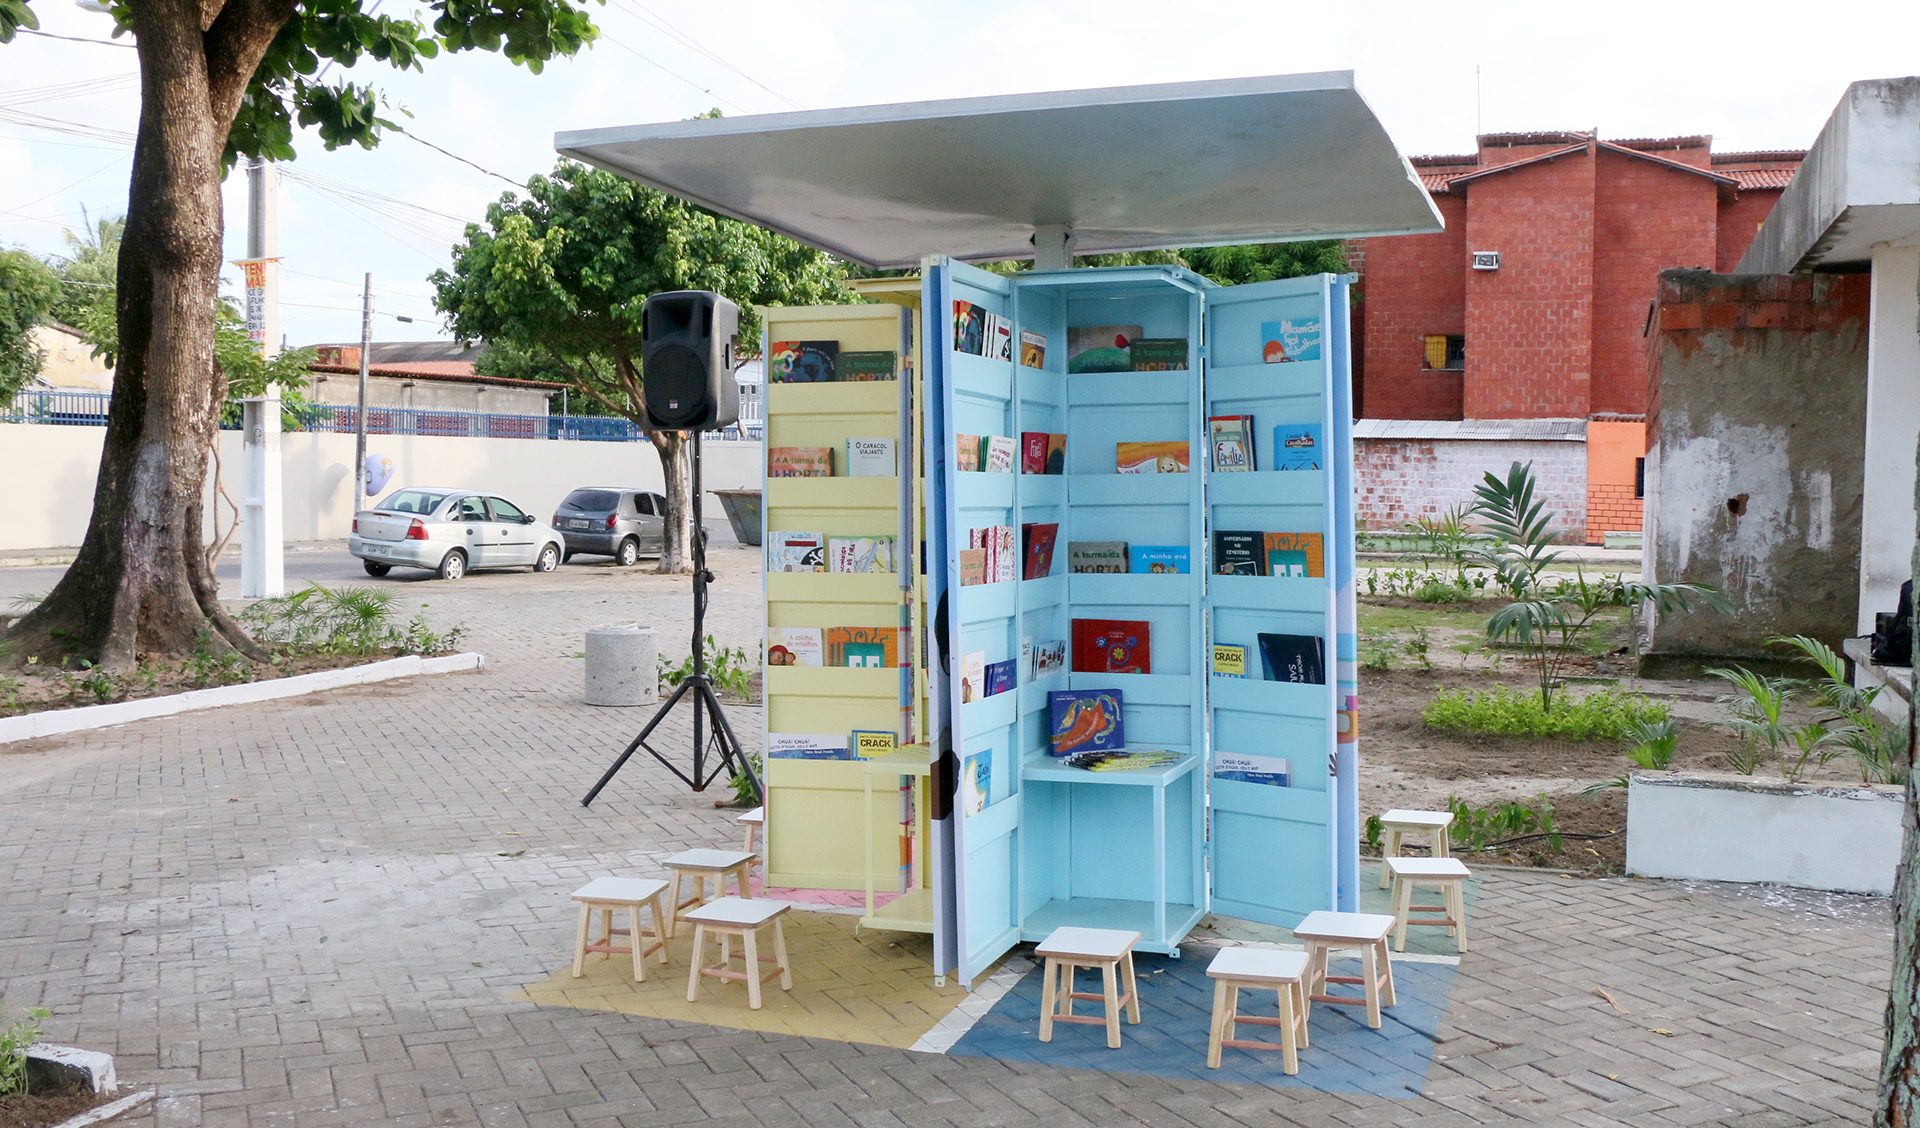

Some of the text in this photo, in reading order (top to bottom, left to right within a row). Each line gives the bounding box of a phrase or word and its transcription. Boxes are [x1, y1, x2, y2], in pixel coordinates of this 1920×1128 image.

[1280, 320, 1320, 334] Mamãe
[1284, 333, 1299, 347] foi
[1135, 362, 1184, 371] HORTA
[846, 372, 892, 381] HORTA
[1082, 551, 1107, 559] turma
[1074, 564, 1121, 573] HORTA
[1214, 652, 1242, 662] CRACK
[860, 738, 891, 748] CRACK
